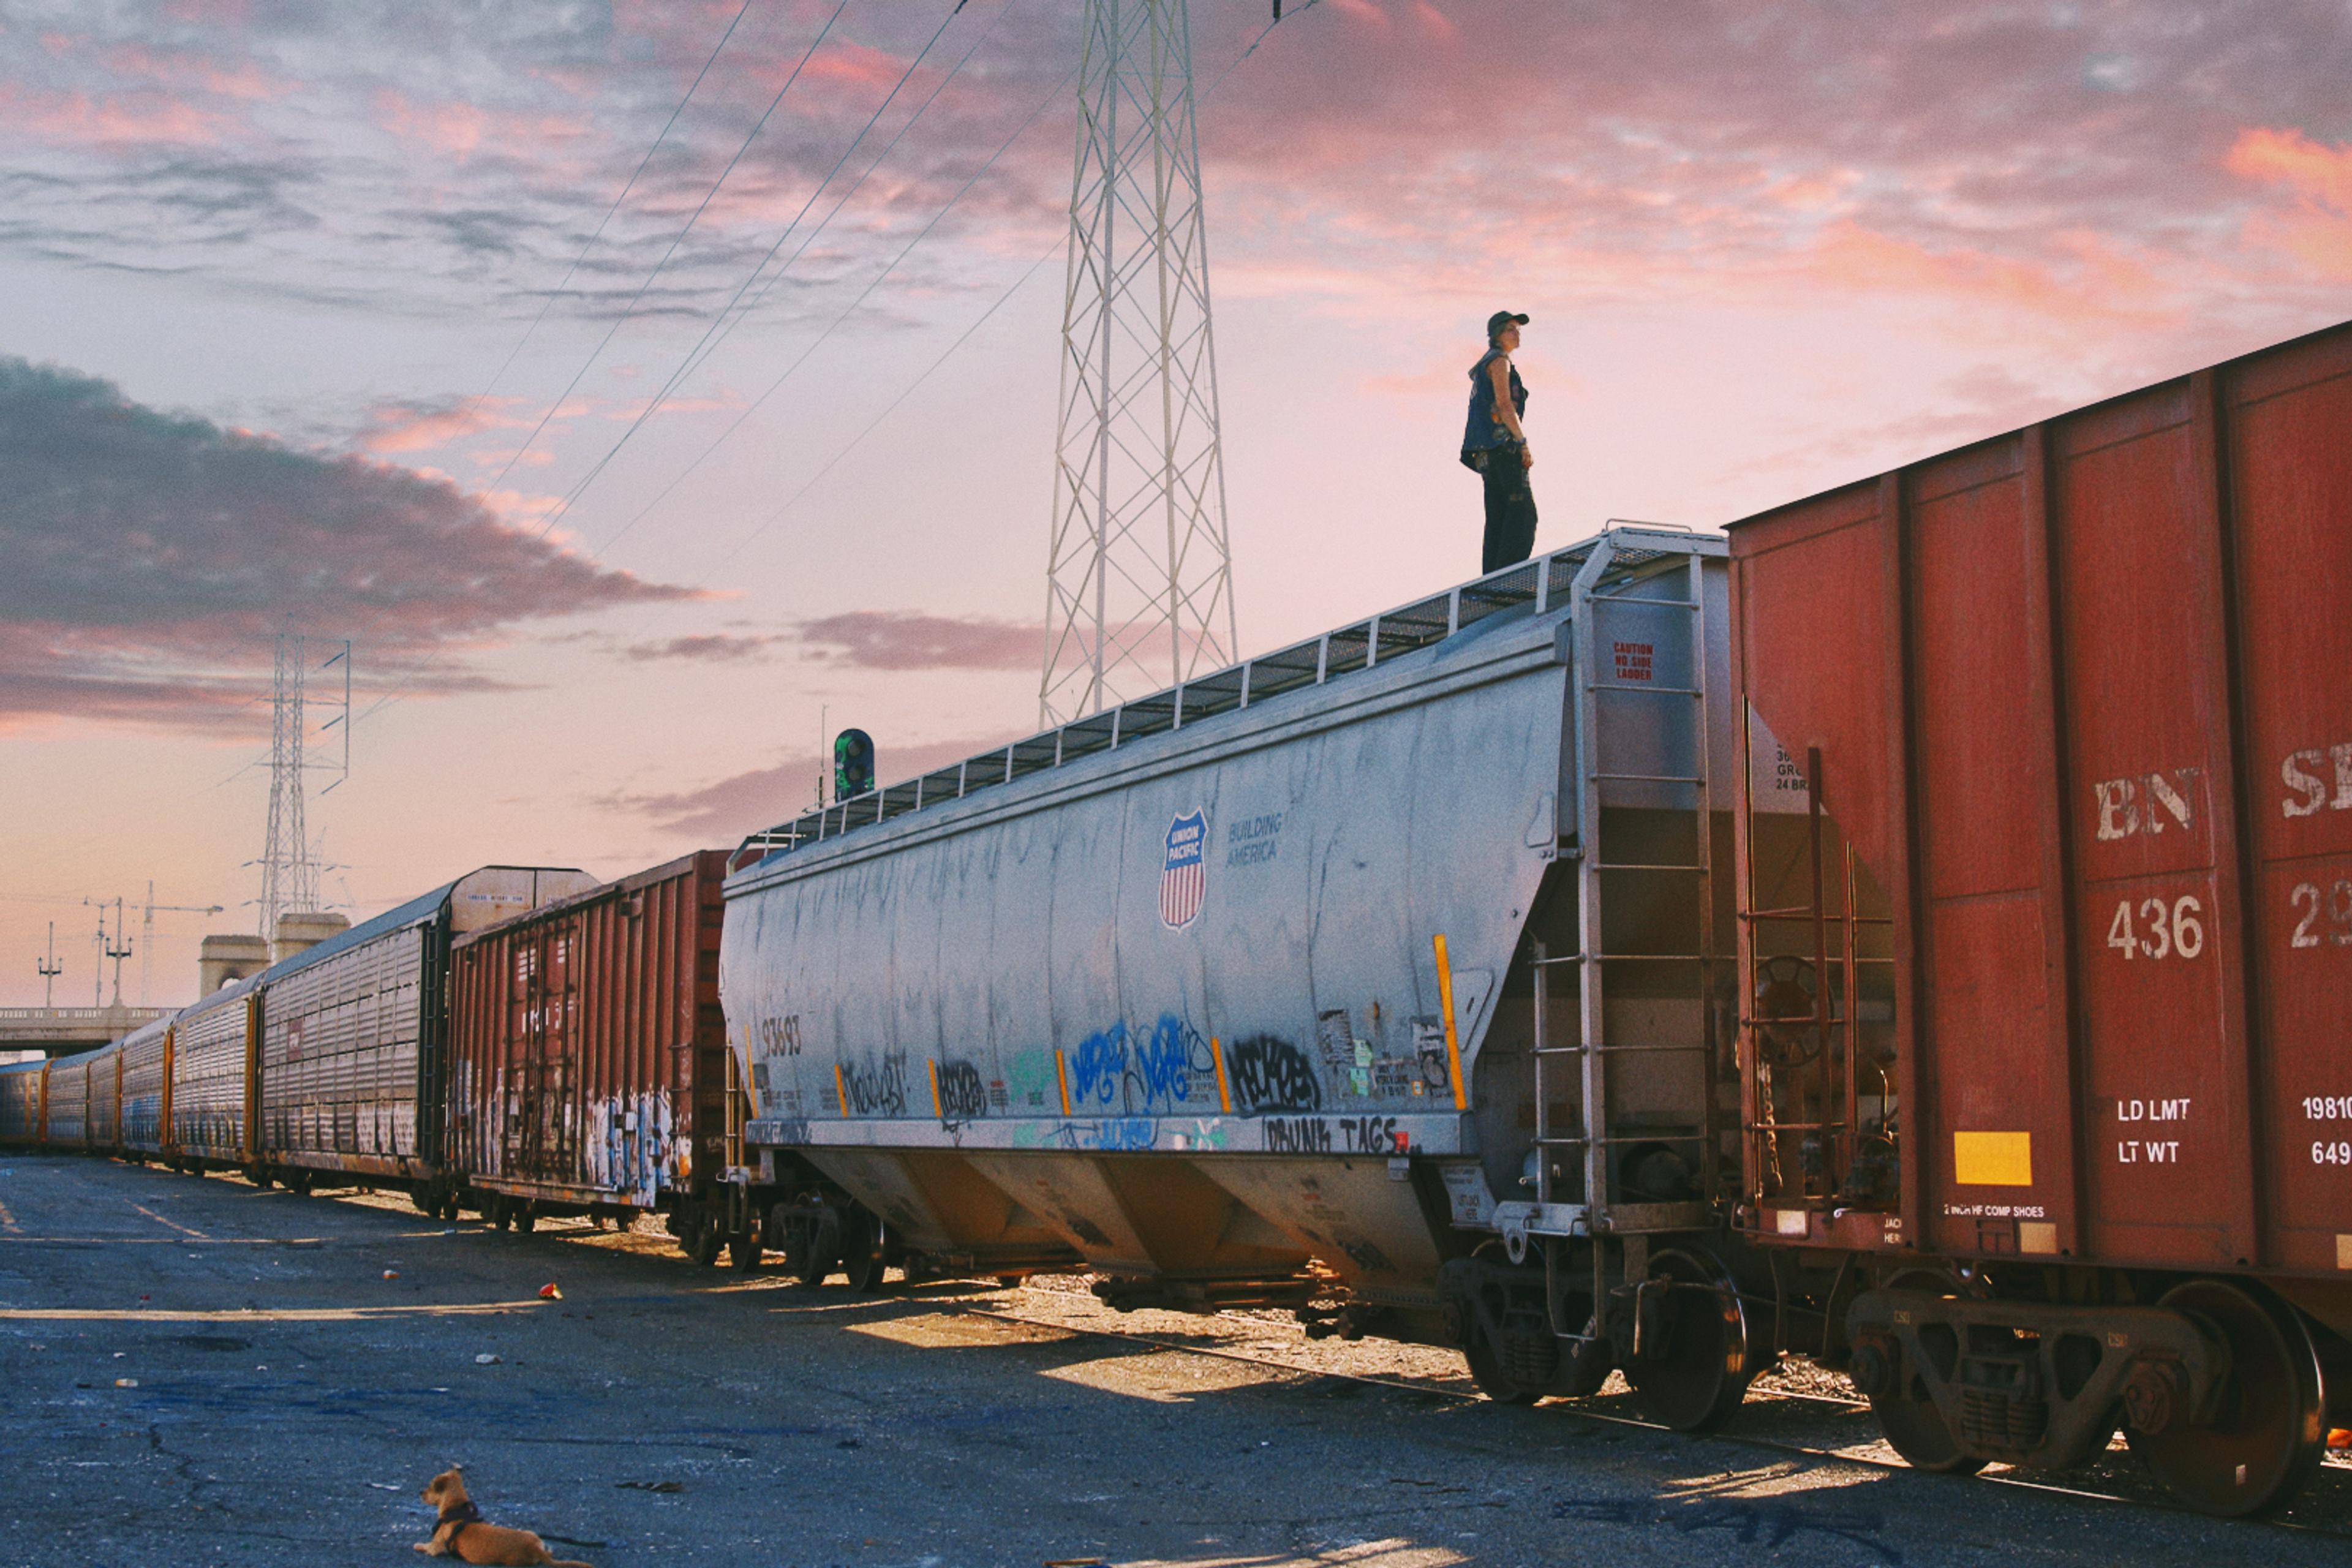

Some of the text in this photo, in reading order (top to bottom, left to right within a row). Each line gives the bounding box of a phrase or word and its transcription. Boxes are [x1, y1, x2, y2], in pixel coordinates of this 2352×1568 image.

[1614, 641, 1653, 655] CAUTION
[1615, 655, 1651, 668] NO SIDE
[1617, 668, 1652, 680] LADDER
[1777, 778, 1788, 790] 24
[2092, 767, 2201, 842] BN
[1171, 824, 1200, 845] UNION
[1228, 812, 1282, 843] BUILDING
[1168, 841, 1200, 862] PACIFIC
[1226, 840, 1278, 867] AMERICA
[2108, 895, 2203, 960] 436
[761, 1014, 802, 1058] 93693
[2118, 1100, 2144, 1120] LD
[2150, 1099, 2190, 1120] LMT
[1267, 1117, 1331, 1154] DRUNK
[2118, 1141, 2351, 1165] LT WT 649
[1951, 1205, 1970, 1216] INCH
[1972, 1205, 1983, 1215] HF
[1985, 1206, 2011, 1216] COMP
[2013, 1207, 2045, 1218] SHOES
